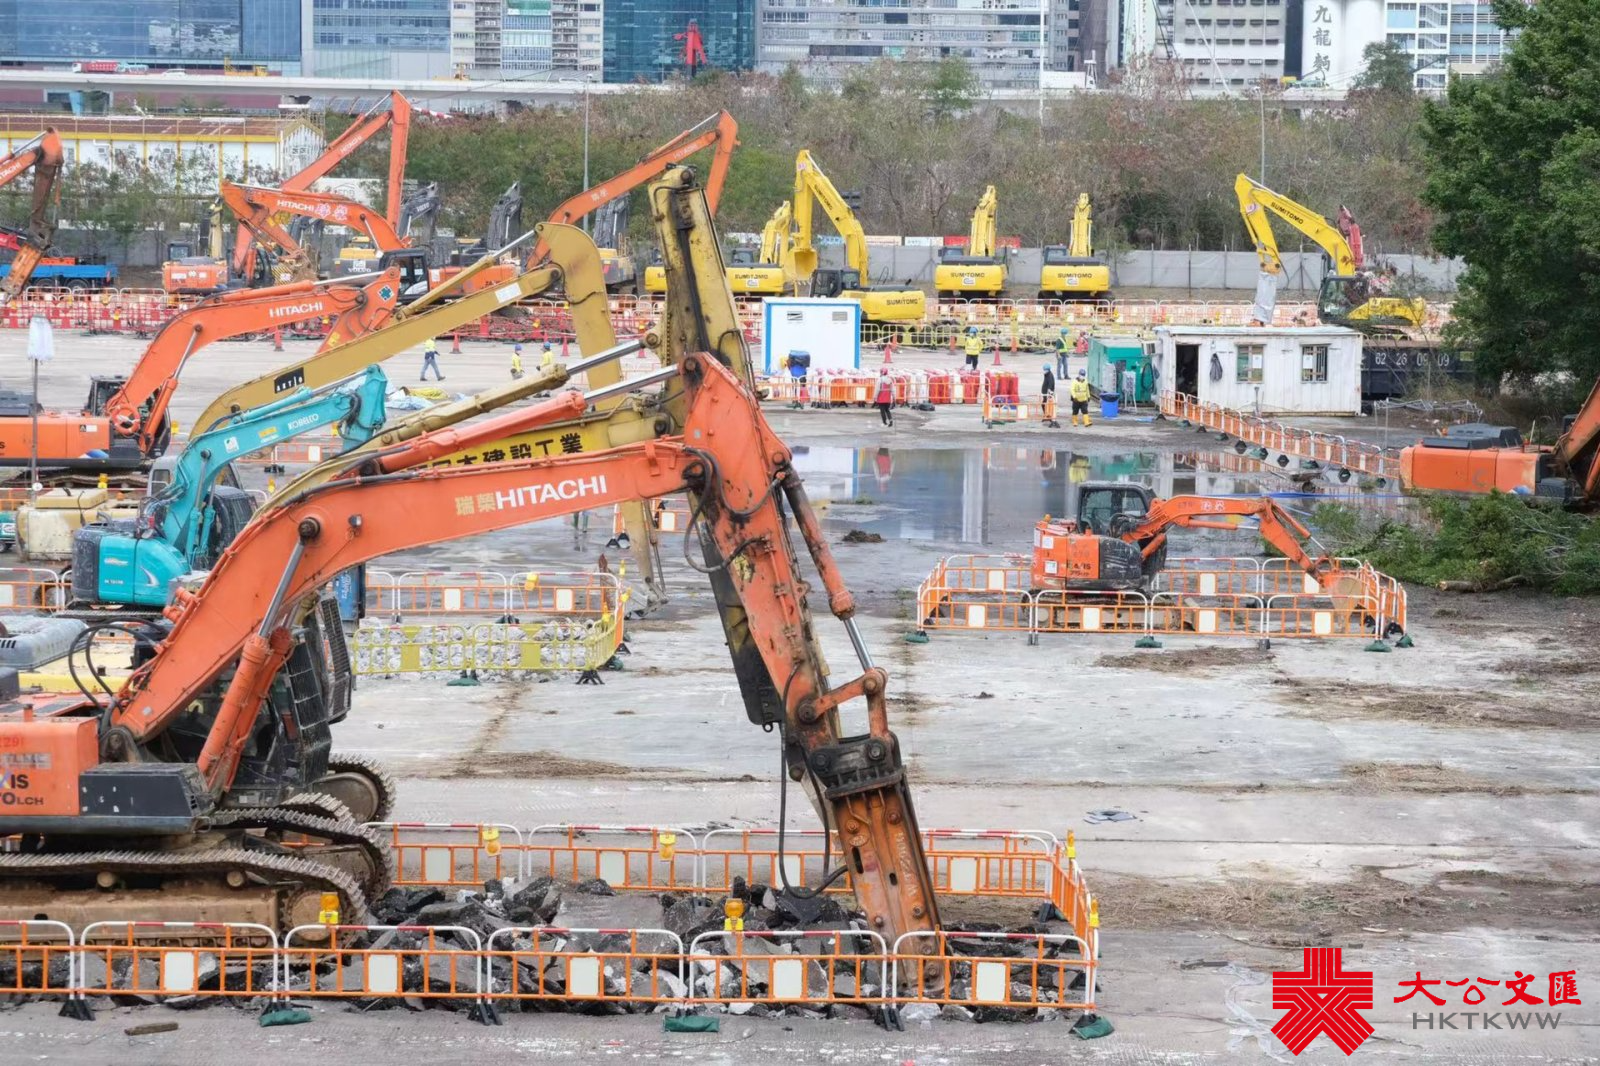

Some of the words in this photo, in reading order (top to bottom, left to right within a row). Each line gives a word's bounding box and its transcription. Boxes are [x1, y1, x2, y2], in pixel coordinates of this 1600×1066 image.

[277, 199, 315, 212] HITACHI
[1270, 202, 1304, 225] SUMITOMO
[269, 301, 324, 318] HITACHI
[287, 413, 319, 430] KOBELCO
[494, 474, 608, 510] HITACHI
